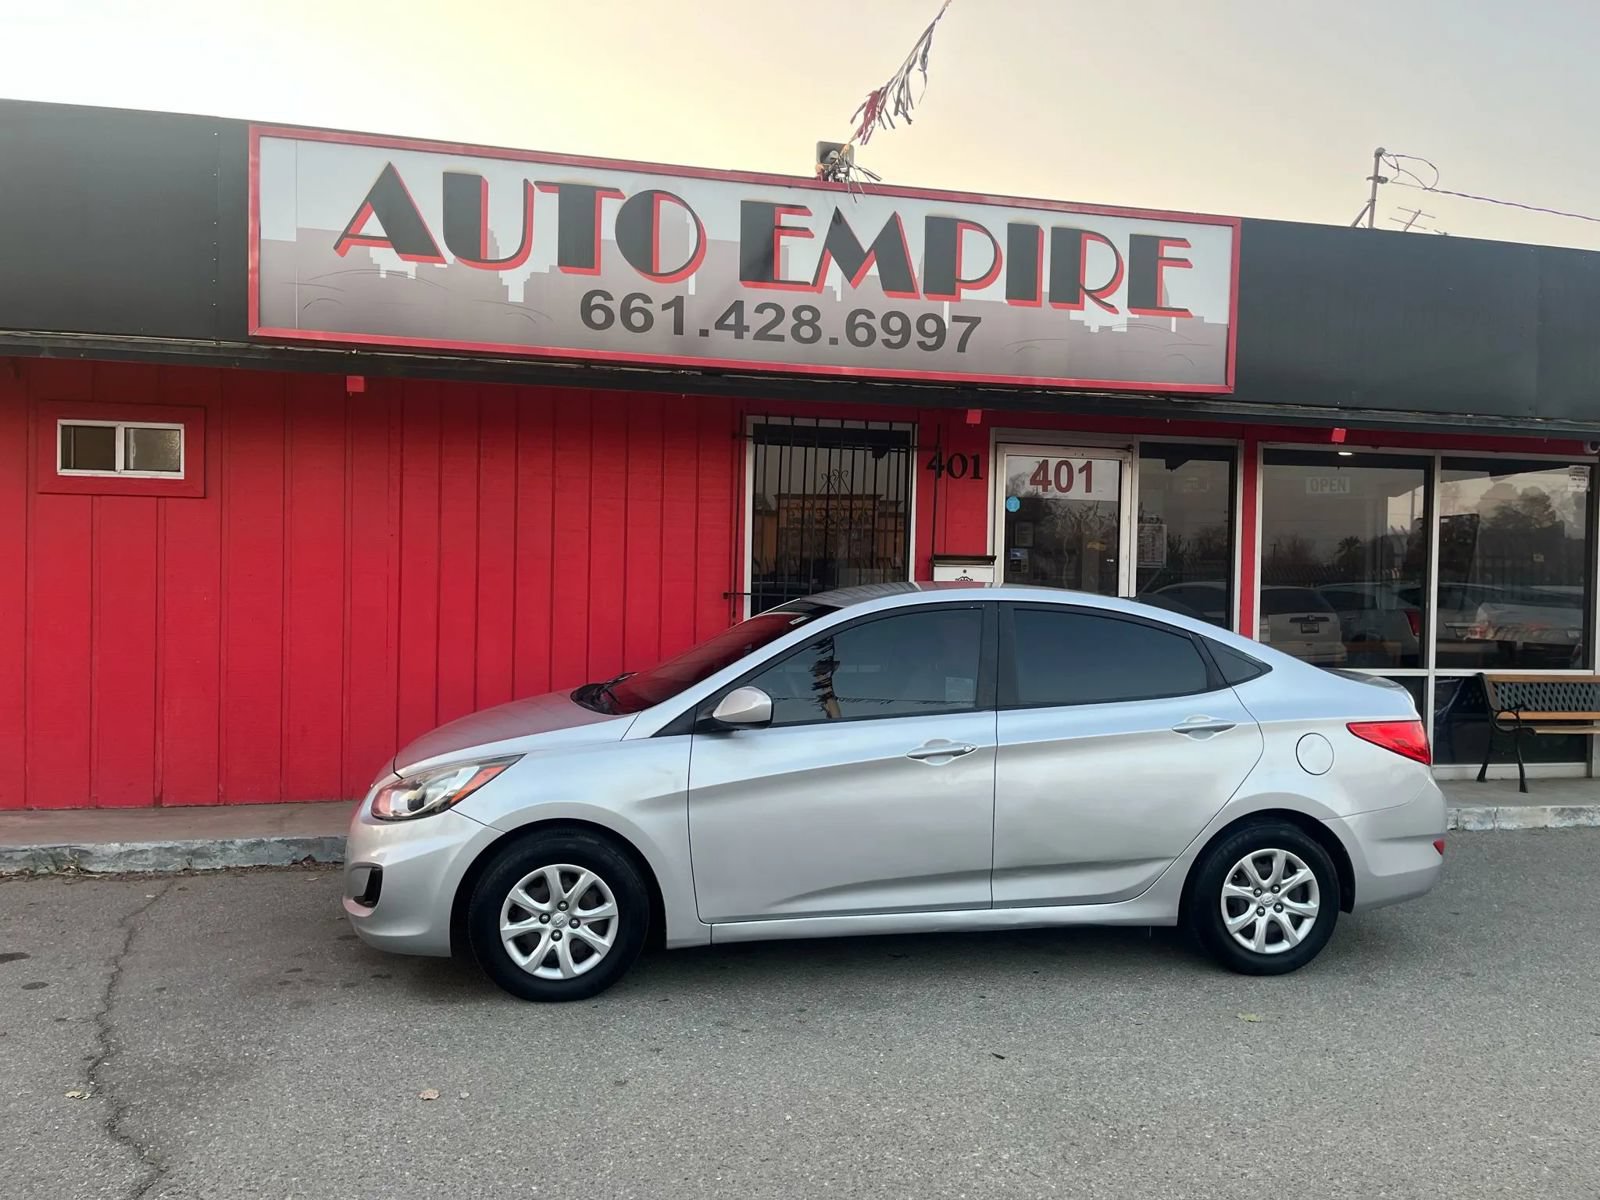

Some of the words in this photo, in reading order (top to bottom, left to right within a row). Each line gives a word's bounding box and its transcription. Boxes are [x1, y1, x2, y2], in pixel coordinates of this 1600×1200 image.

[334, 162, 706, 283] AUTO
[740, 200, 1194, 318] EMPIRE
[580, 289, 982, 353] 661.428.6997
[927, 450, 984, 480] 401
[1030, 459, 1093, 494] 401
[1310, 478, 1347, 492] OPEN
